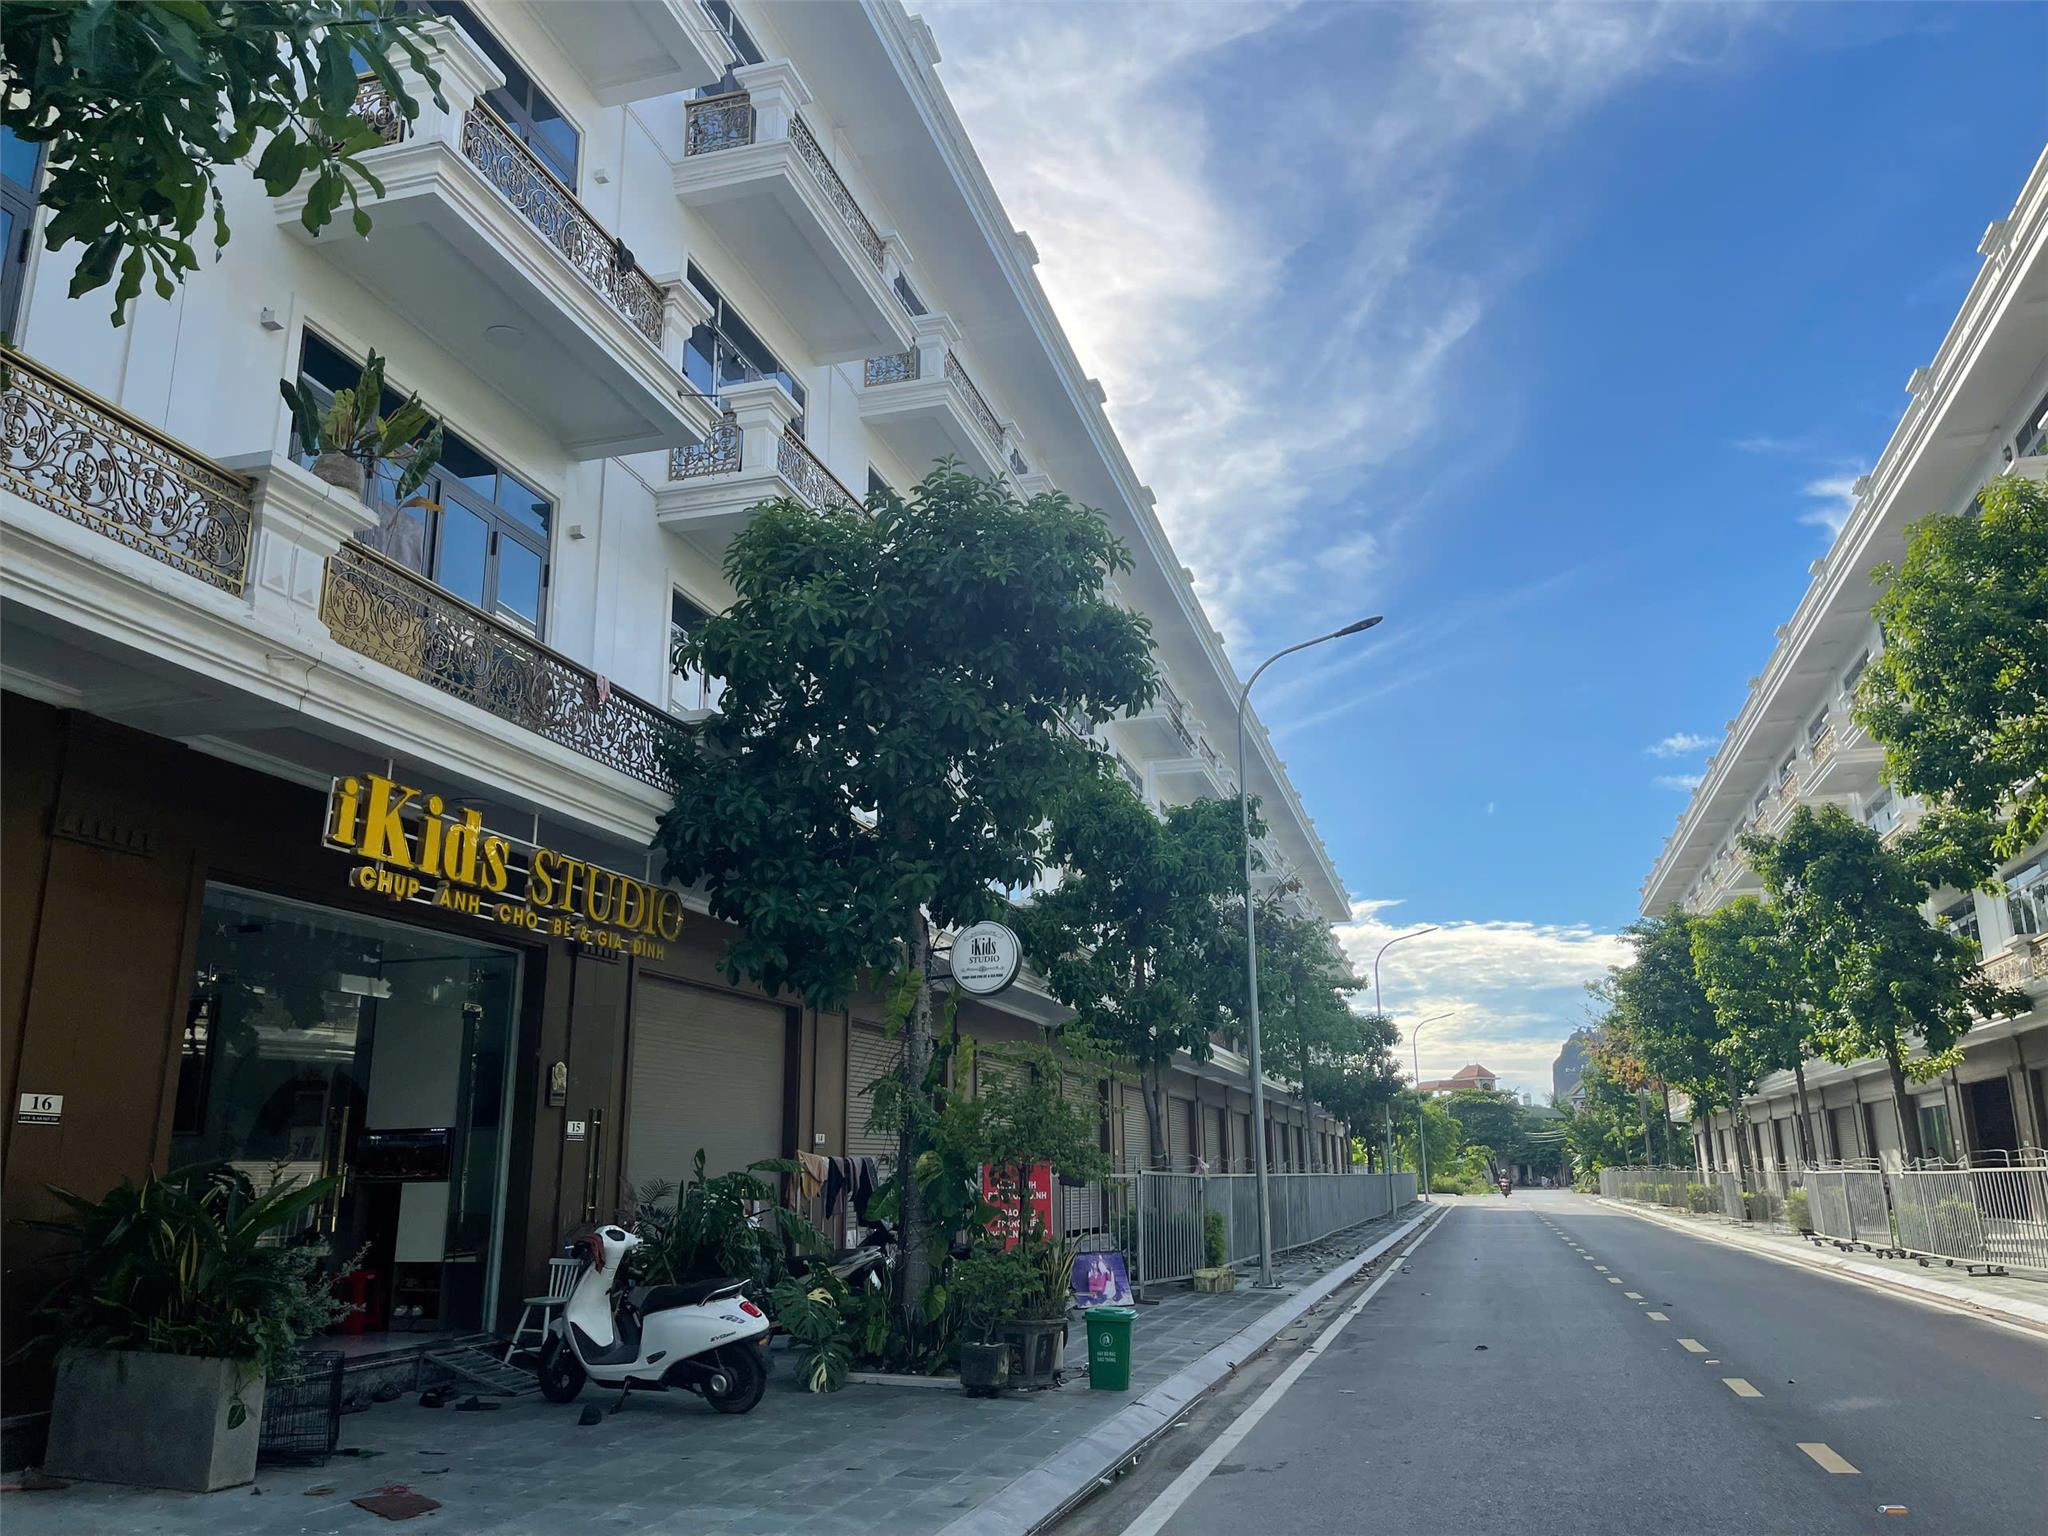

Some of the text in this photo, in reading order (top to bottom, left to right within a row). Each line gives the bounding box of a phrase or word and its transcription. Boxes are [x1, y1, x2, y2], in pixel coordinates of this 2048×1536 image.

[329, 773, 684, 941] iKids STUDIO
[357, 865, 421, 902] CHỤP
[498, 903, 538, 929] CHO
[552, 916, 571, 936] BÉ
[579, 926, 590, 941] &
[597, 930, 622, 950] GIA
[971, 937, 997, 955] iKids
[969, 955, 1000, 964] STUDIO
[31, 1096, 53, 1110] 16
[572, 1122, 581, 1132] 15
